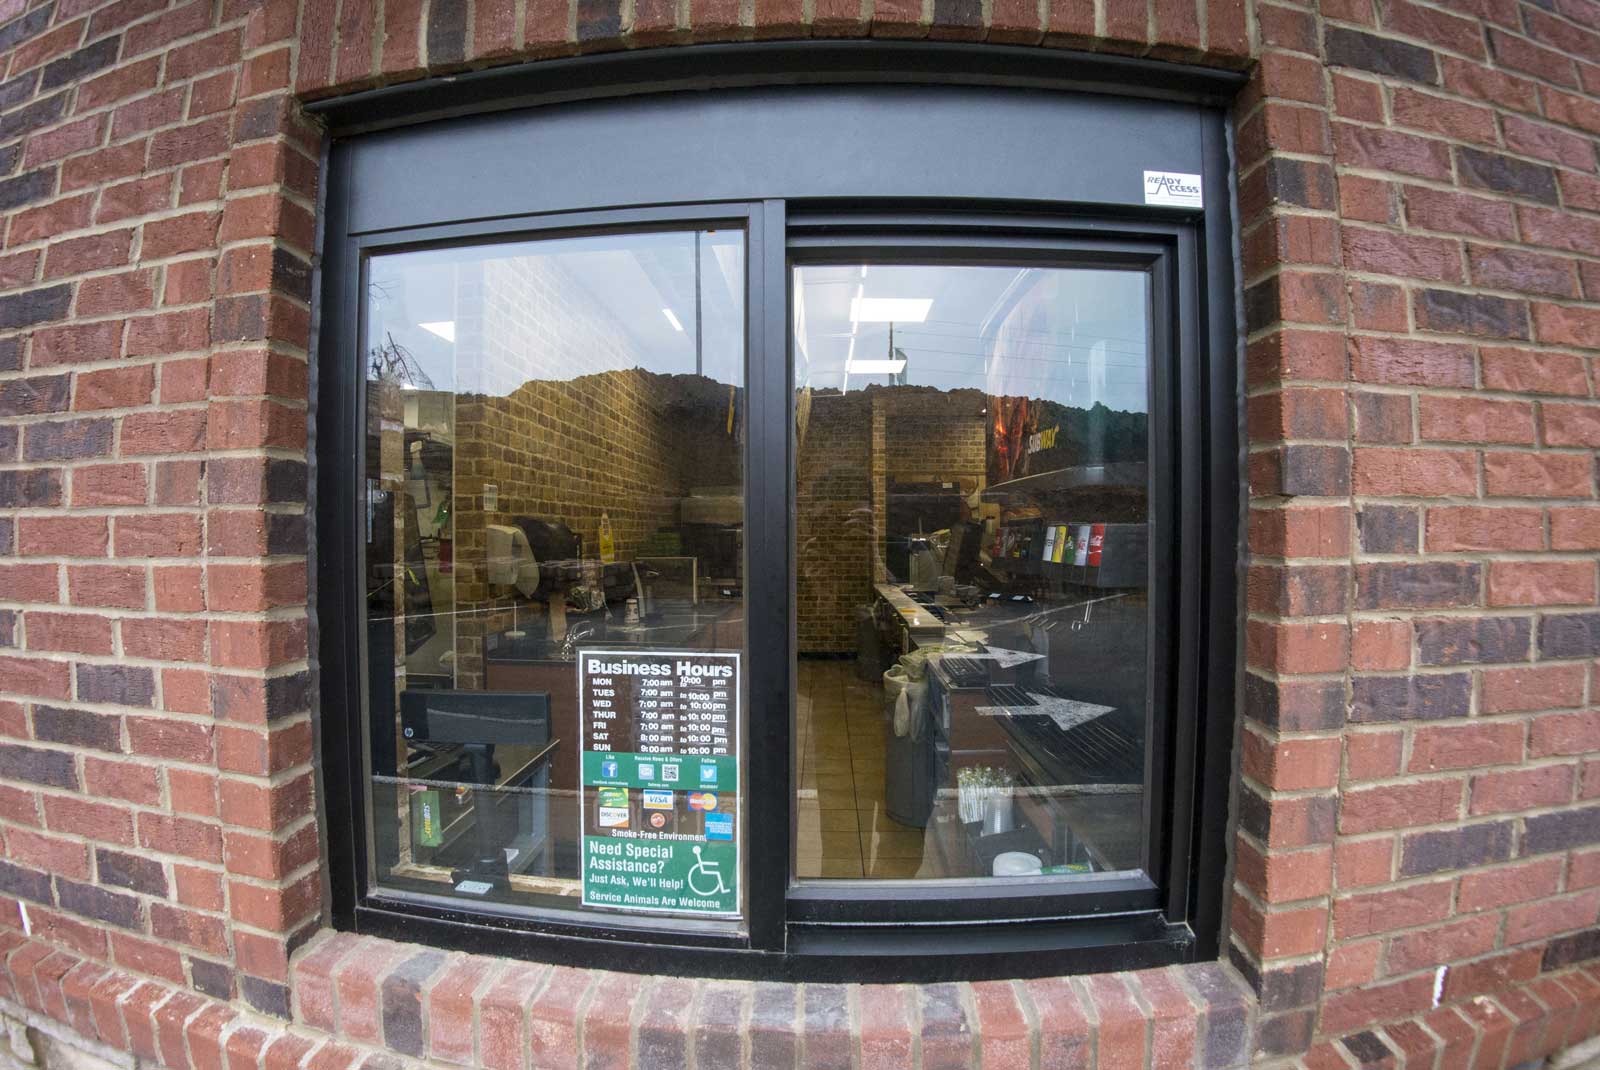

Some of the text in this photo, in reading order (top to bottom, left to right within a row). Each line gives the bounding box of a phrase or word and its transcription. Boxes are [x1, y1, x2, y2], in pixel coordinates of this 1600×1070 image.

[1147, 175, 1181, 185] READY
[588, 659, 733, 676] Business Hours
[712, 726, 725, 734] pm
[714, 736, 727, 744] pm
[612, 829, 657, 840] Smoke-Free
[589, 841, 673, 859] Need Special
[589, 856, 664, 873] Assistance?
[589, 874, 683, 889] Just Ask, We'll Help!
[590, 891, 720, 908] Service Animals Are Welcome
